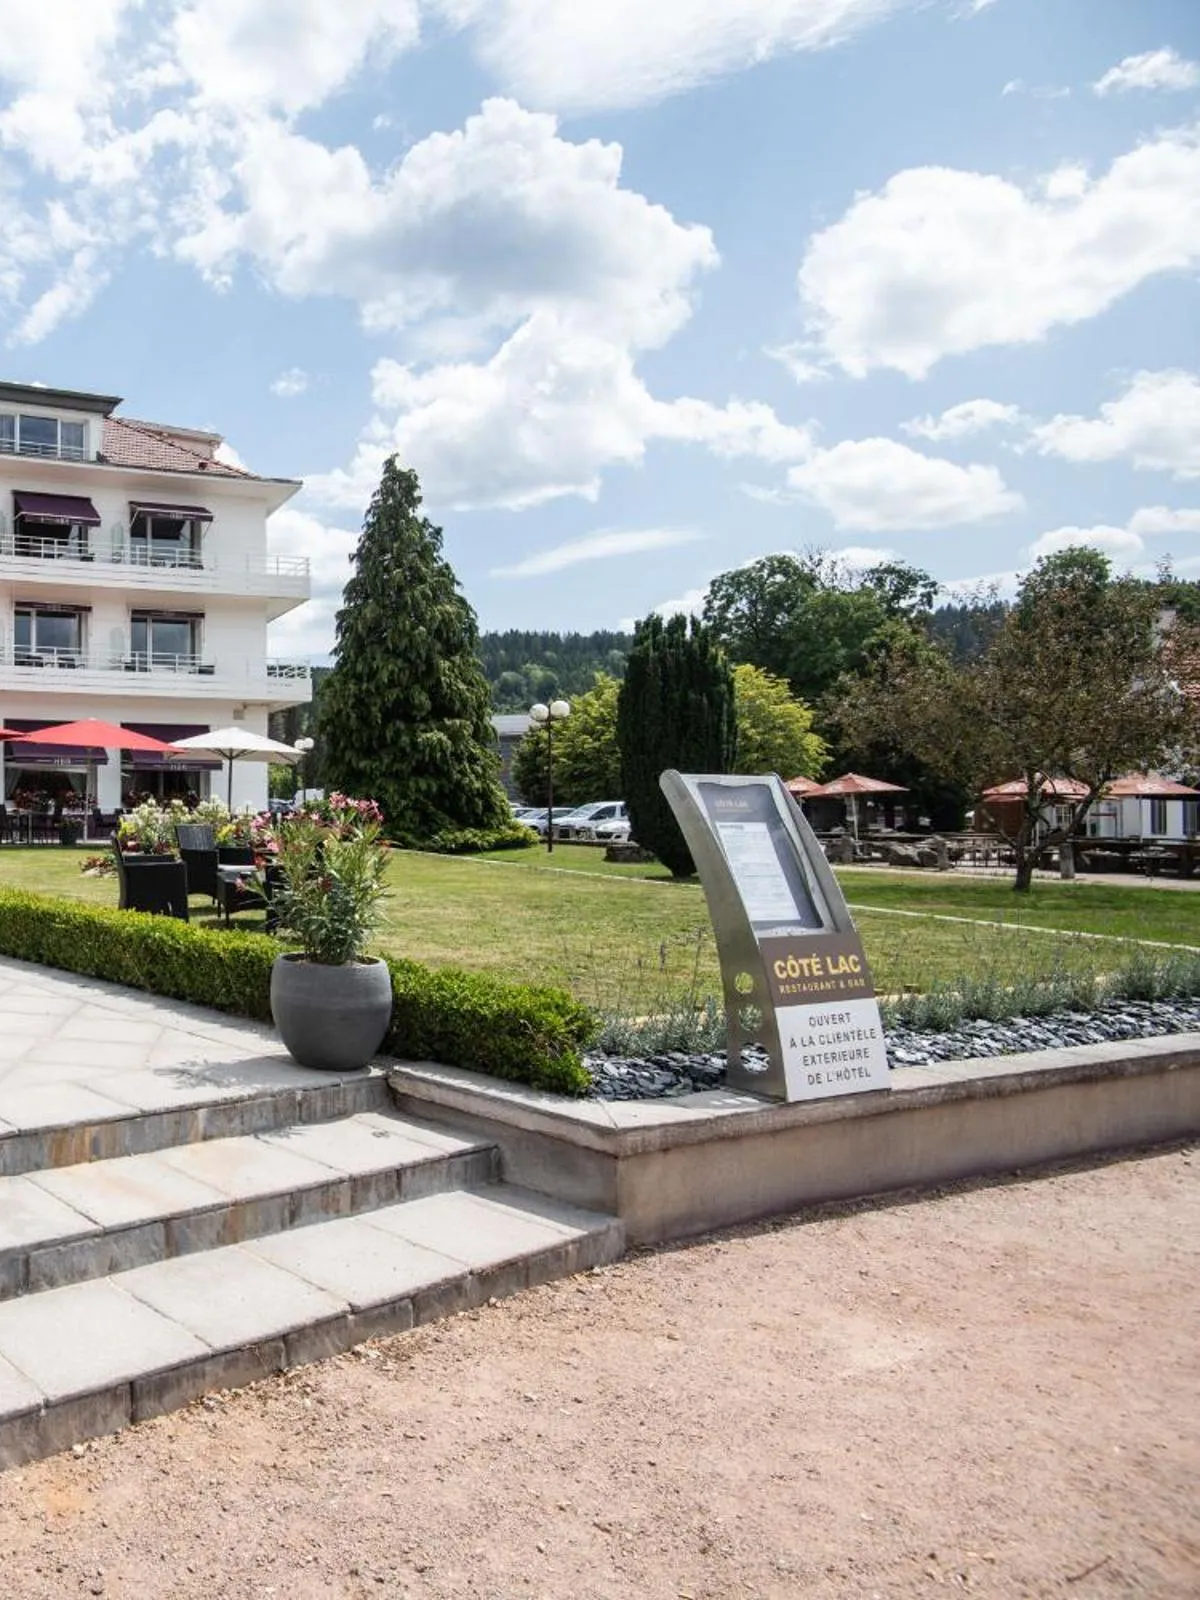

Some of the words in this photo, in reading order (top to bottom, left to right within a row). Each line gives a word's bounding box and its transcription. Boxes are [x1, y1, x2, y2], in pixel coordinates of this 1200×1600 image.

[774, 953, 824, 979] CÔTÉ
[826, 954, 861, 975] LAC
[779, 980, 836, 994] RESTAURANT
[808, 1012, 851, 1028] OUVERT
[801, 1035, 816, 1048] LA
[807, 1072, 823, 1086] DE
